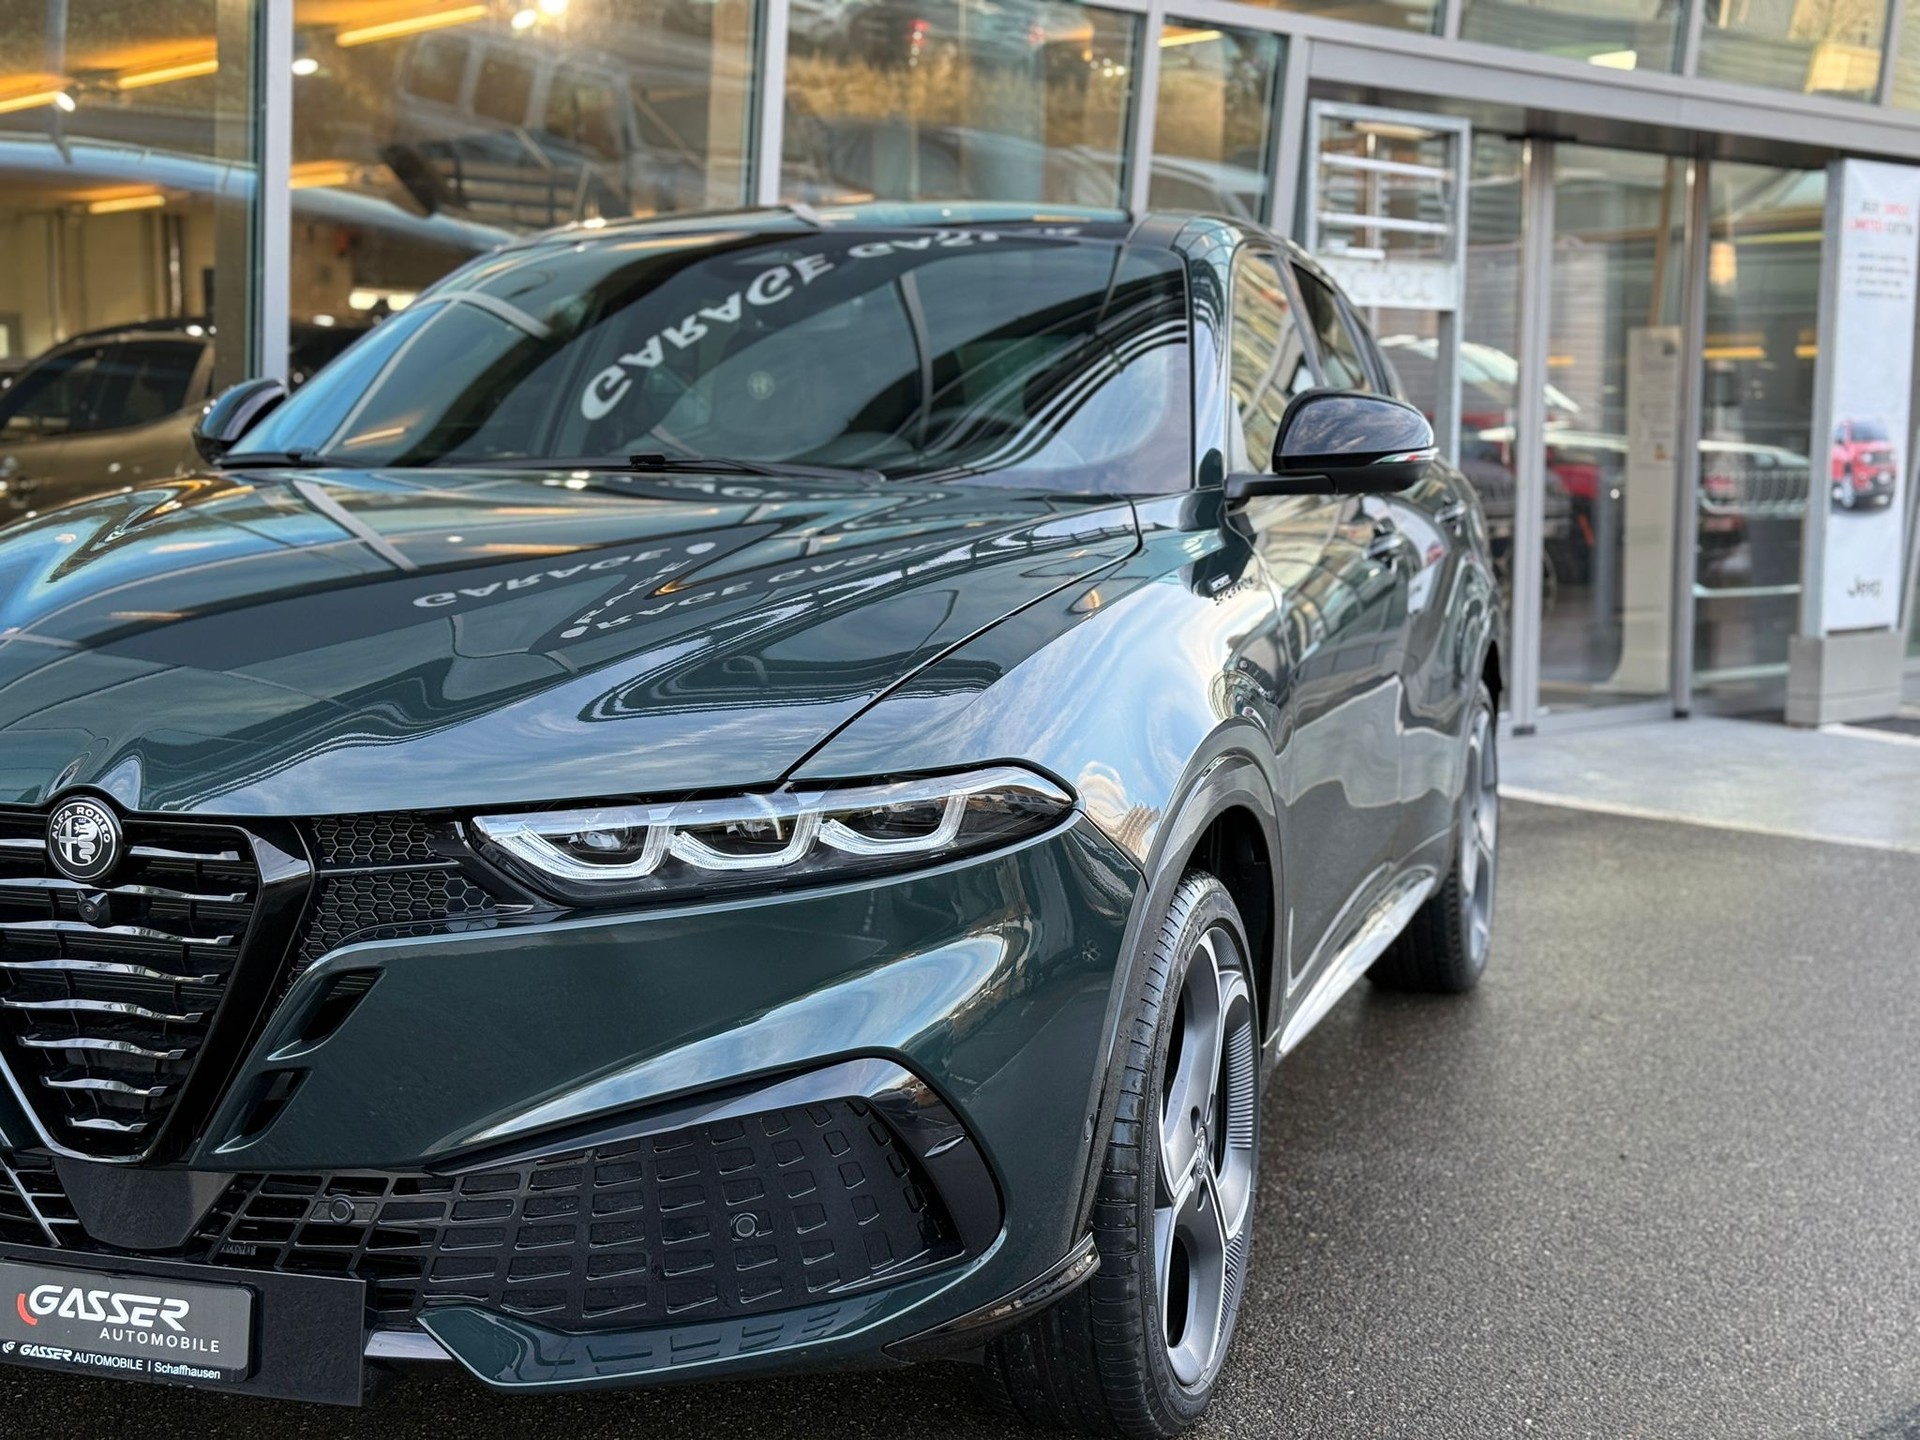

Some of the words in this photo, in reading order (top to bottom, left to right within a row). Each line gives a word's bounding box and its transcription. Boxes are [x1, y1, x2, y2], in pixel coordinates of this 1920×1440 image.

[51, 810, 72, 840] ALFA
[76, 806, 110, 844] ROMEO
[29, 1284, 190, 1332] GASSER
[99, 1326, 220, 1353] AUTOMOBILE
[20, 1344, 73, 1362] GASSER
[73, 1352, 143, 1371] AUTOMOBILE
[154, 1361, 221, 1380] Schaffhausen
